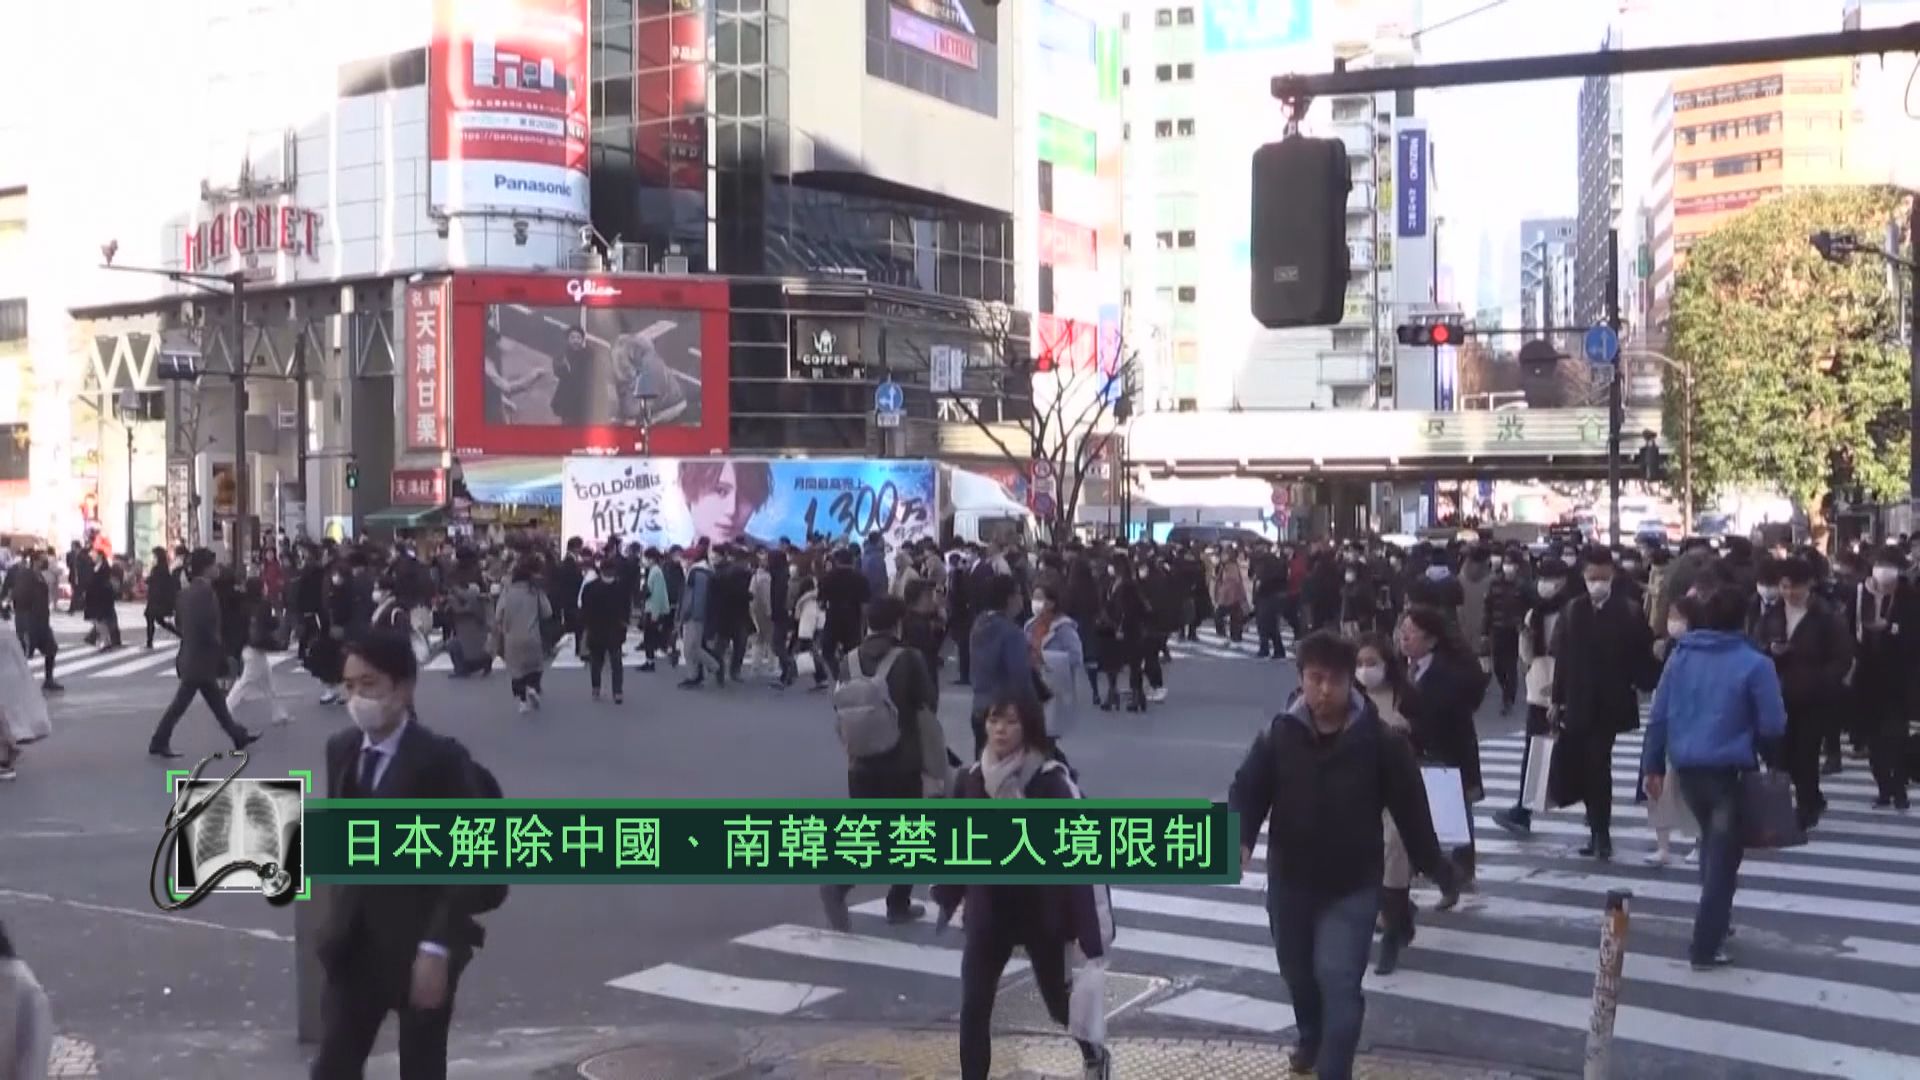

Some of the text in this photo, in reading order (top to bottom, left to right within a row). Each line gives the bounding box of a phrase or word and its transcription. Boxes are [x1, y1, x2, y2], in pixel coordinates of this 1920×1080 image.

[494, 173, 573, 197] Panasonic
[185, 203, 323, 273] MAGNET
[566, 279, 622, 302] Glico
[803, 354, 848, 366] COFFEE
[416, 310, 437, 443] 天津甘栗
